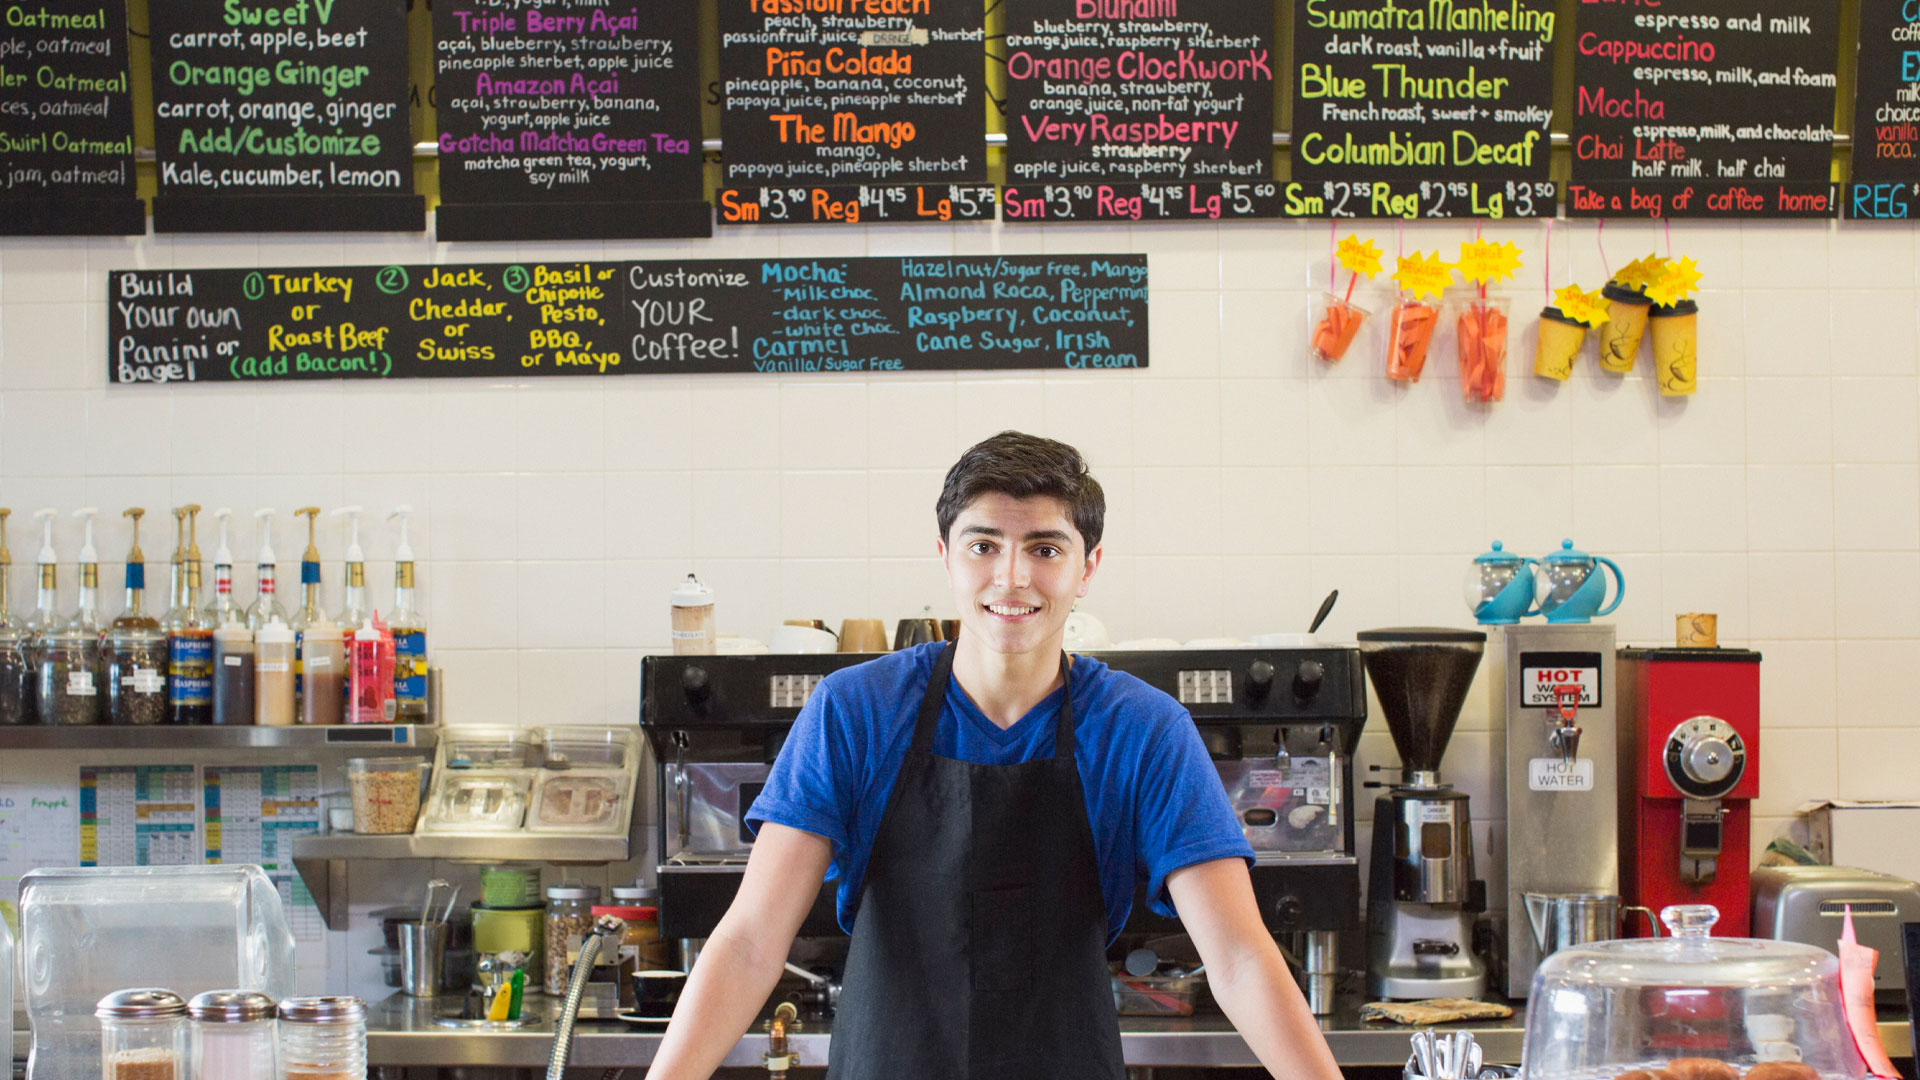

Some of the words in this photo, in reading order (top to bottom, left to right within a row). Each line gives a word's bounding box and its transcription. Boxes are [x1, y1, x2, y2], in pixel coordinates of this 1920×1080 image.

[7, 6, 104, 28] Oatmeal
[224, 0, 309, 26] Sweet
[314, 0, 334, 24] V
[453, 11, 515, 36] Triple
[527, 10, 585, 33] Berry
[591, 8, 637, 36] Açai
[1307, 0, 1424, 31] Sumatra
[1429, 0, 1555, 42] Manheling
[1634, 14, 1720, 33] espresso
[1726, 13, 1762, 32] and
[37, 38, 110, 55] oatmeal
[170, 29, 245, 50] carrot,
[250, 28, 313, 54] apple,
[317, 27, 367, 47] beet
[481, 36, 565, 53] blueberry,
[572, 35, 672, 55] strawberry,
[819, 32, 860, 45] juice,
[931, 28, 984, 41] sherbet
[1377, 36, 1423, 59] roast,
[1426, 38, 1485, 59] vanilla
[1498, 38, 1544, 61] fruit
[1578, 32, 1715, 64] Cappuccino
[766, 47, 821, 76] Piña
[825, 47, 911, 76] Colada
[1008, 51, 1111, 85] Orange
[38, 66, 126, 92] Oatmeal
[170, 61, 270, 95] Orange
[276, 60, 369, 97] Ginger
[477, 72, 565, 95] Amazon
[570, 72, 618, 99] Açai
[1301, 63, 1366, 99] Blue
[1372, 64, 1508, 99] Thunder
[1633, 67, 1712, 85] espresso,
[1758, 67, 1790, 85] and
[1792, 67, 1837, 87] foam
[40, 95, 109, 119] oatmeal
[1323, 101, 1379, 121] French
[1382, 102, 1426, 124] roast,
[1432, 105, 1478, 121] sweet
[1578, 85, 1664, 120] Mocha
[180, 126, 380, 156] Add/Customize
[438, 132, 513, 152] Gotcha
[521, 131, 589, 152] Matcha
[592, 133, 646, 152] Green
[651, 134, 689, 153] Tea
[769, 114, 825, 144] The
[833, 112, 916, 149] Mango
[1021, 115, 1086, 146] Very
[1090, 112, 1239, 149] Raspberry
[53, 132, 131, 154] Oatmeal
[1092, 144, 1191, 162] strawberry
[1301, 131, 1445, 166] Columbian
[1453, 130, 1540, 166] Decaf
[1577, 134, 1623, 159] Chai
[1636, 138, 1685, 160] Latte
[8, 161, 46, 189] jam,
[52, 164, 124, 183] oatmeal
[1014, 160, 1056, 178] apple
[1060, 160, 1105, 178] juice,
[1110, 159, 1186, 178] raspberry
[1194, 159, 1262, 175] sherbert
[721, 190, 759, 221] Sm
[812, 188, 859, 223] Reg
[917, 187, 951, 220] Lg
[1004, 188, 1045, 218] Sm
[1097, 186, 1142, 219] Reg
[1190, 185, 1221, 219] Lg
[1285, 183, 1323, 216] Sm
[1372, 182, 1418, 219] Reg
[1471, 183, 1503, 219] Lg
[1569, 185, 1605, 210] Take
[1611, 196, 1622, 210] a
[1631, 187, 1661, 218] bag
[1672, 187, 1694, 210] of
[1707, 187, 1764, 210] coffee
[1854, 184, 1907, 218] REG
[1467, 248, 1504, 260] LARGE
[423, 267, 492, 291] Jack,
[534, 264, 591, 287] Basil
[597, 269, 615, 280] or
[630, 266, 749, 289] Customize
[1401, 261, 1444, 281] REGULAR
[121, 273, 193, 298] Build
[267, 272, 352, 303] Turkey
[526, 285, 604, 307] Chipotle
[900, 280, 985, 302] Almond
[993, 282, 1054, 301] Roca,
[118, 301, 179, 330] Your
[186, 307, 241, 330] own
[291, 305, 320, 321] or
[409, 298, 512, 322] Cheddar,
[540, 304, 605, 326] Pesto,
[632, 298, 713, 328] YOUR
[908, 306, 1024, 333] Raspberry,
[1033, 305, 1134, 327] Coconut,
[269, 326, 335, 352] Roast
[339, 322, 389, 352] Beef
[444, 323, 470, 337] or
[530, 329, 592, 351] BBQ,
[916, 332, 973, 352] Cane
[979, 331, 1049, 353] Sugar,
[1056, 330, 1110, 350] Irish
[119, 335, 208, 363] Panini
[216, 341, 239, 356] or
[417, 338, 495, 361] Swiss
[632, 326, 738, 361] Coffee!
[753, 338, 848, 360] Carmel
[118, 359, 195, 382] Bagel
[521, 353, 543, 367] or
[555, 350, 620, 373] Mayo
[870, 357, 904, 372] Free
[1065, 351, 1138, 369] Cream
[1538, 670, 1582, 682] HOT
[1532, 694, 1590, 702] SYSTEM
[1547, 762, 1574, 773] HOT
[1538, 775, 1584, 785] WATER
